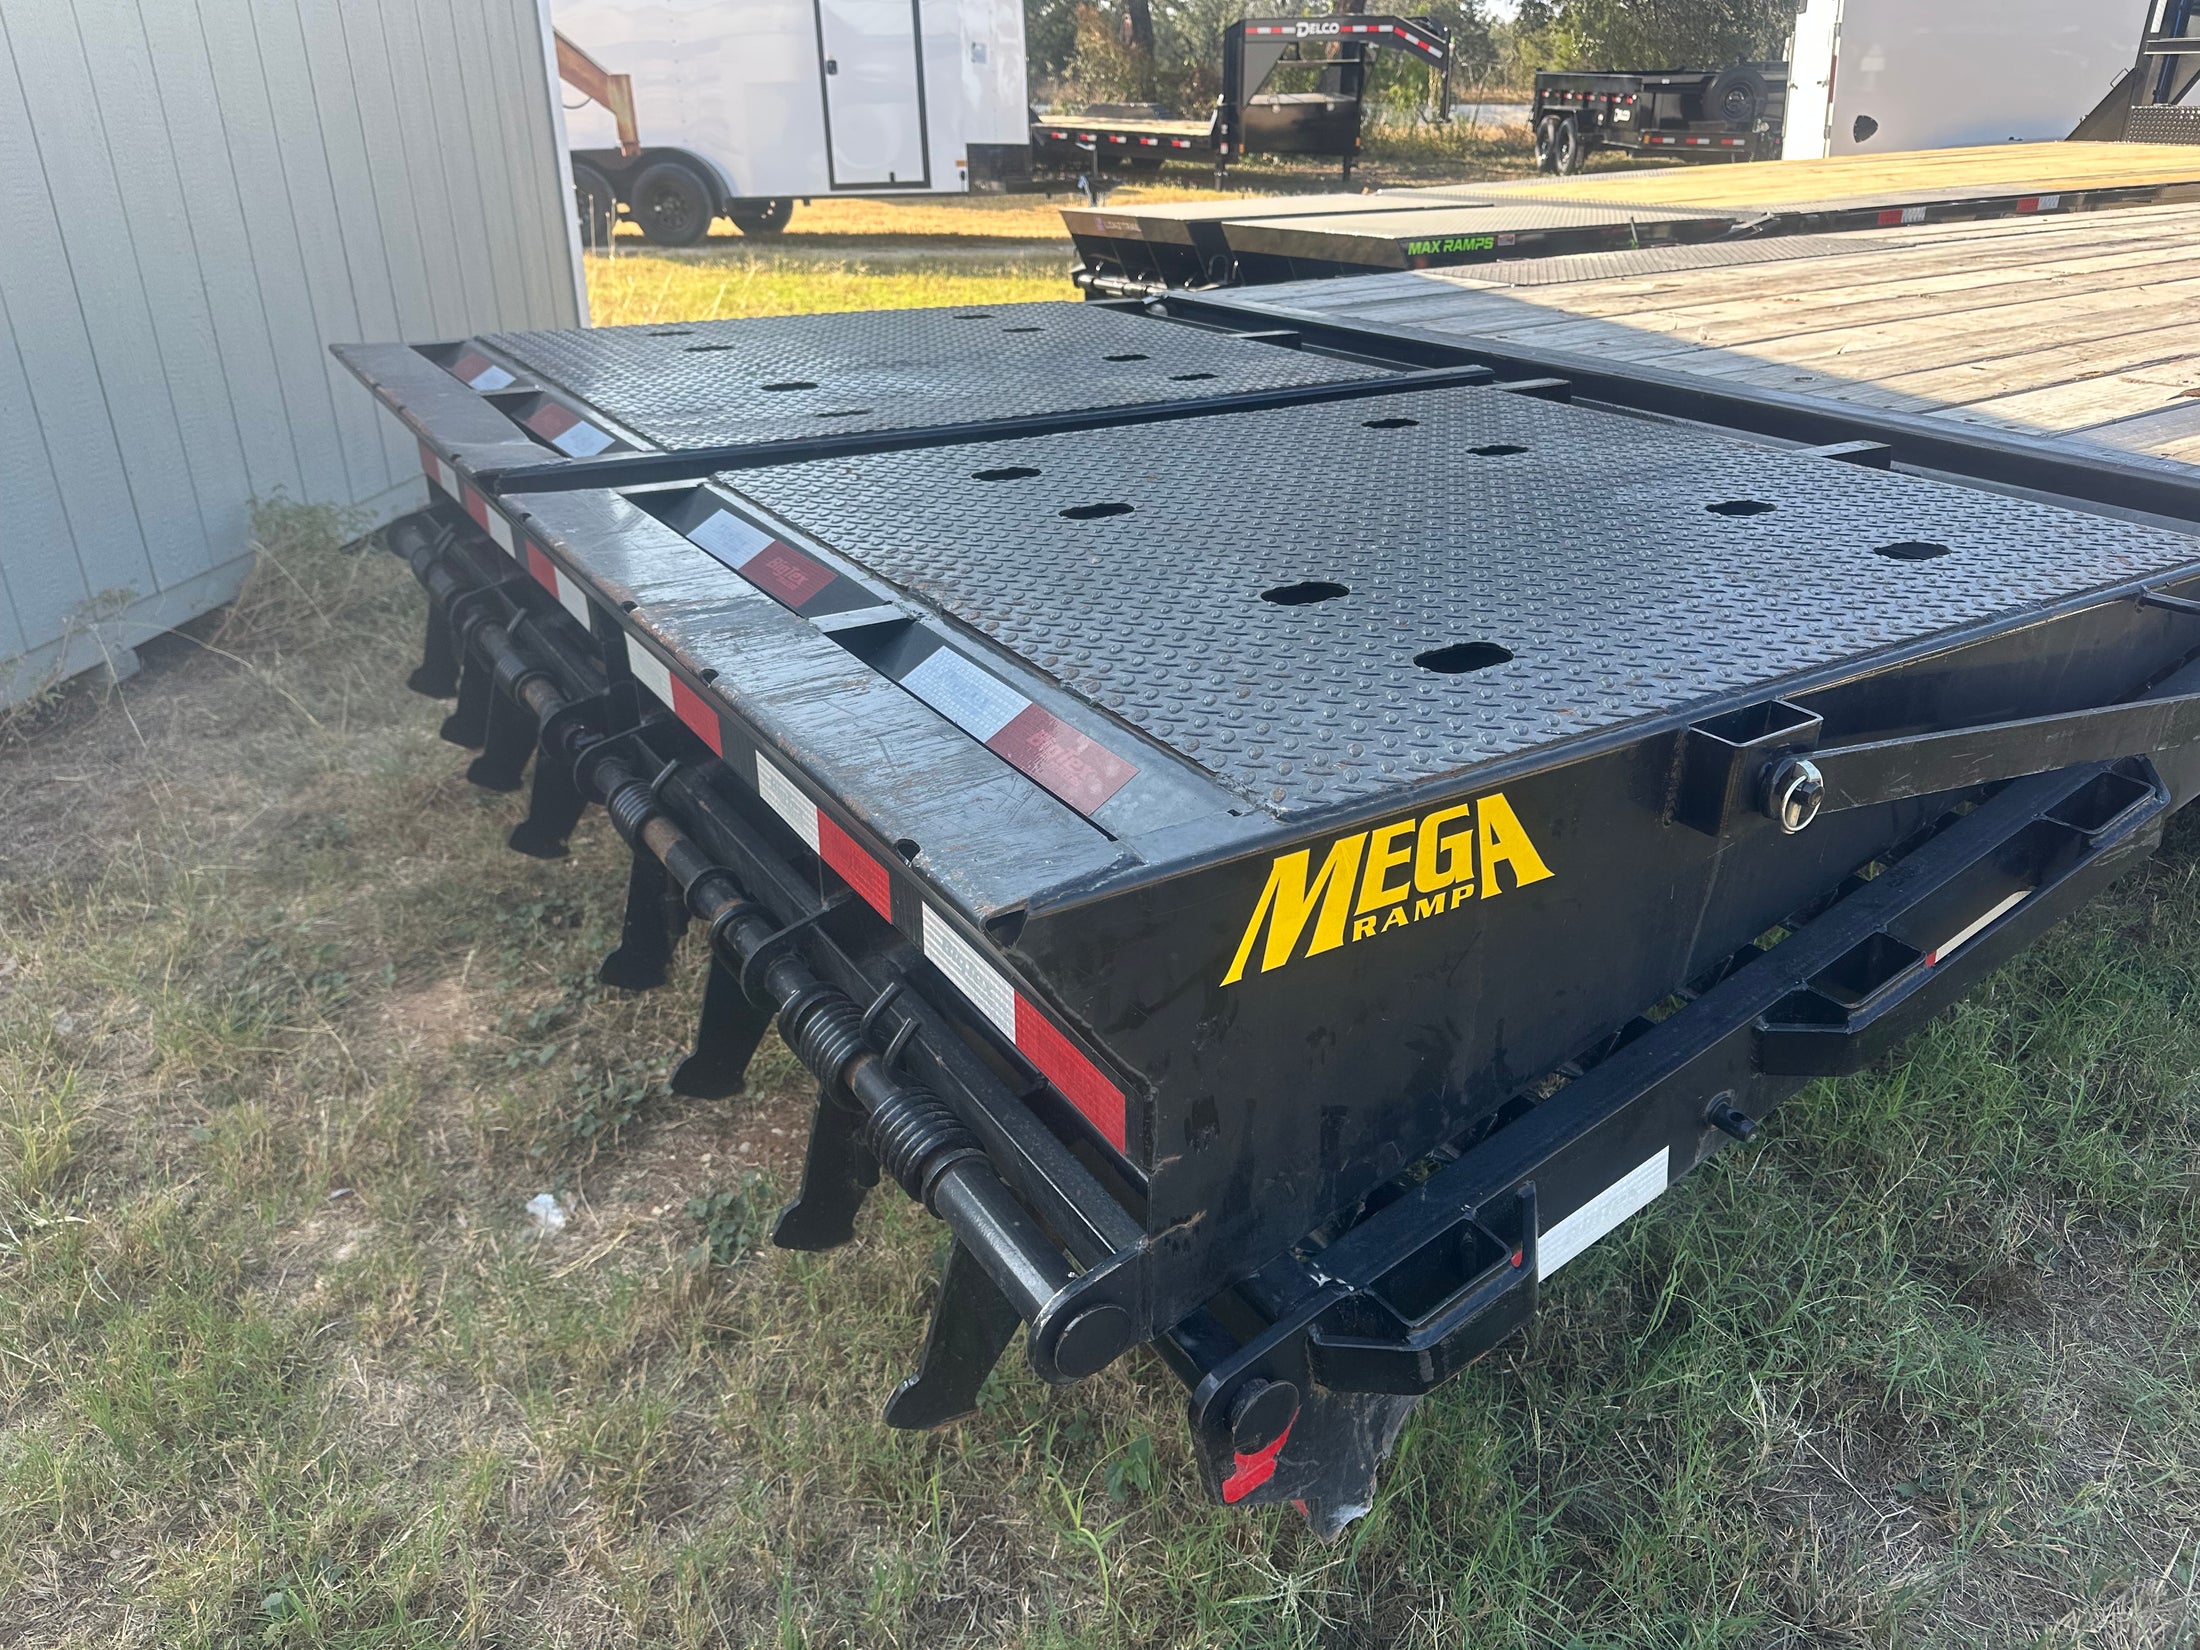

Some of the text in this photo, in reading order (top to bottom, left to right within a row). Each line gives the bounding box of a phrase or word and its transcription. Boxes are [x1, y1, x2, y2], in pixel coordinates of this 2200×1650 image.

[1296, 21, 1340, 38] DELCO
[1408, 240, 1442, 256] MAX
[1443, 237, 1495, 253] RAMPS
[1219, 792, 1556, 987] MEGA
[1352, 883, 1475, 943] RAMP
